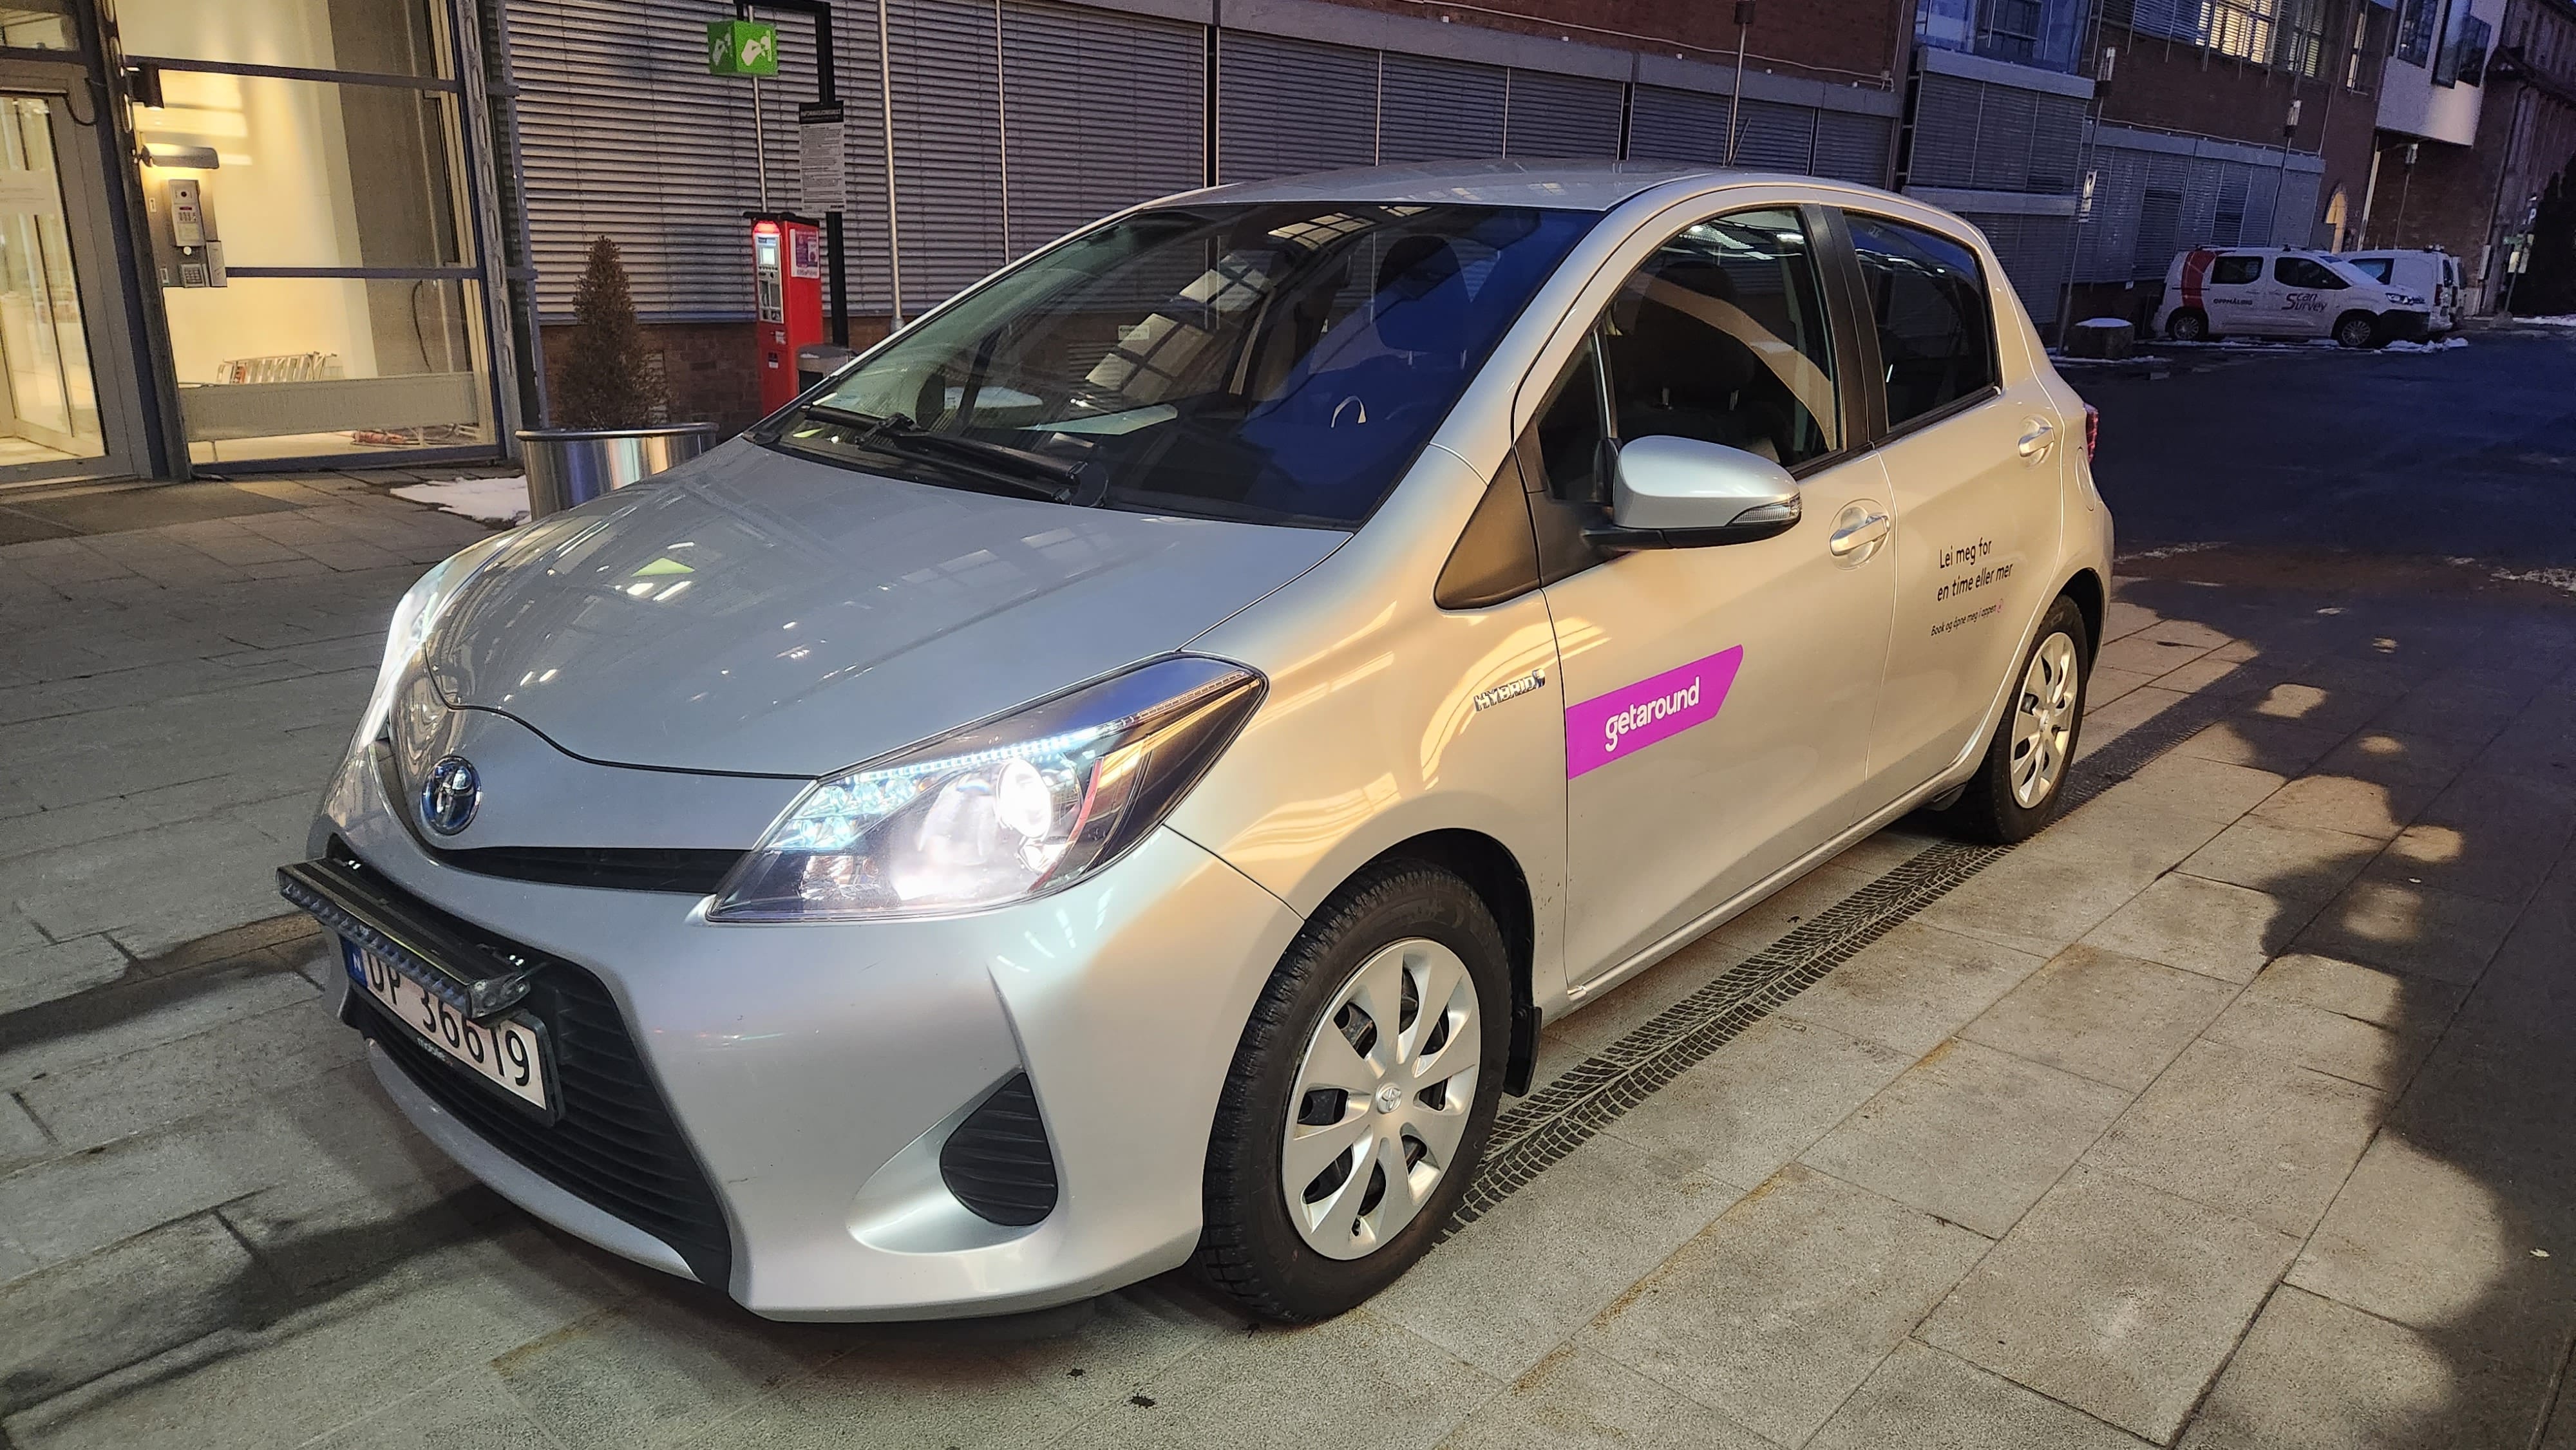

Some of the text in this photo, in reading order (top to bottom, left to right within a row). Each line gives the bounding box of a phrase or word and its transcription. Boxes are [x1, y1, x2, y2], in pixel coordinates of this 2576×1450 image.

[1940, 537, 1992, 569] Lei meg for
[1937, 563, 2013, 601] en time eller mer
[1931, 622, 1944, 636] Book
[1946, 621, 1953, 633] og
[1967, 612, 1978, 623] meg
[1473, 675, 1535, 711] HYBRID
[1605, 677, 1700, 751] getaround
[353, 953, 361, 972] N
[421, 988, 530, 1086] 36619
